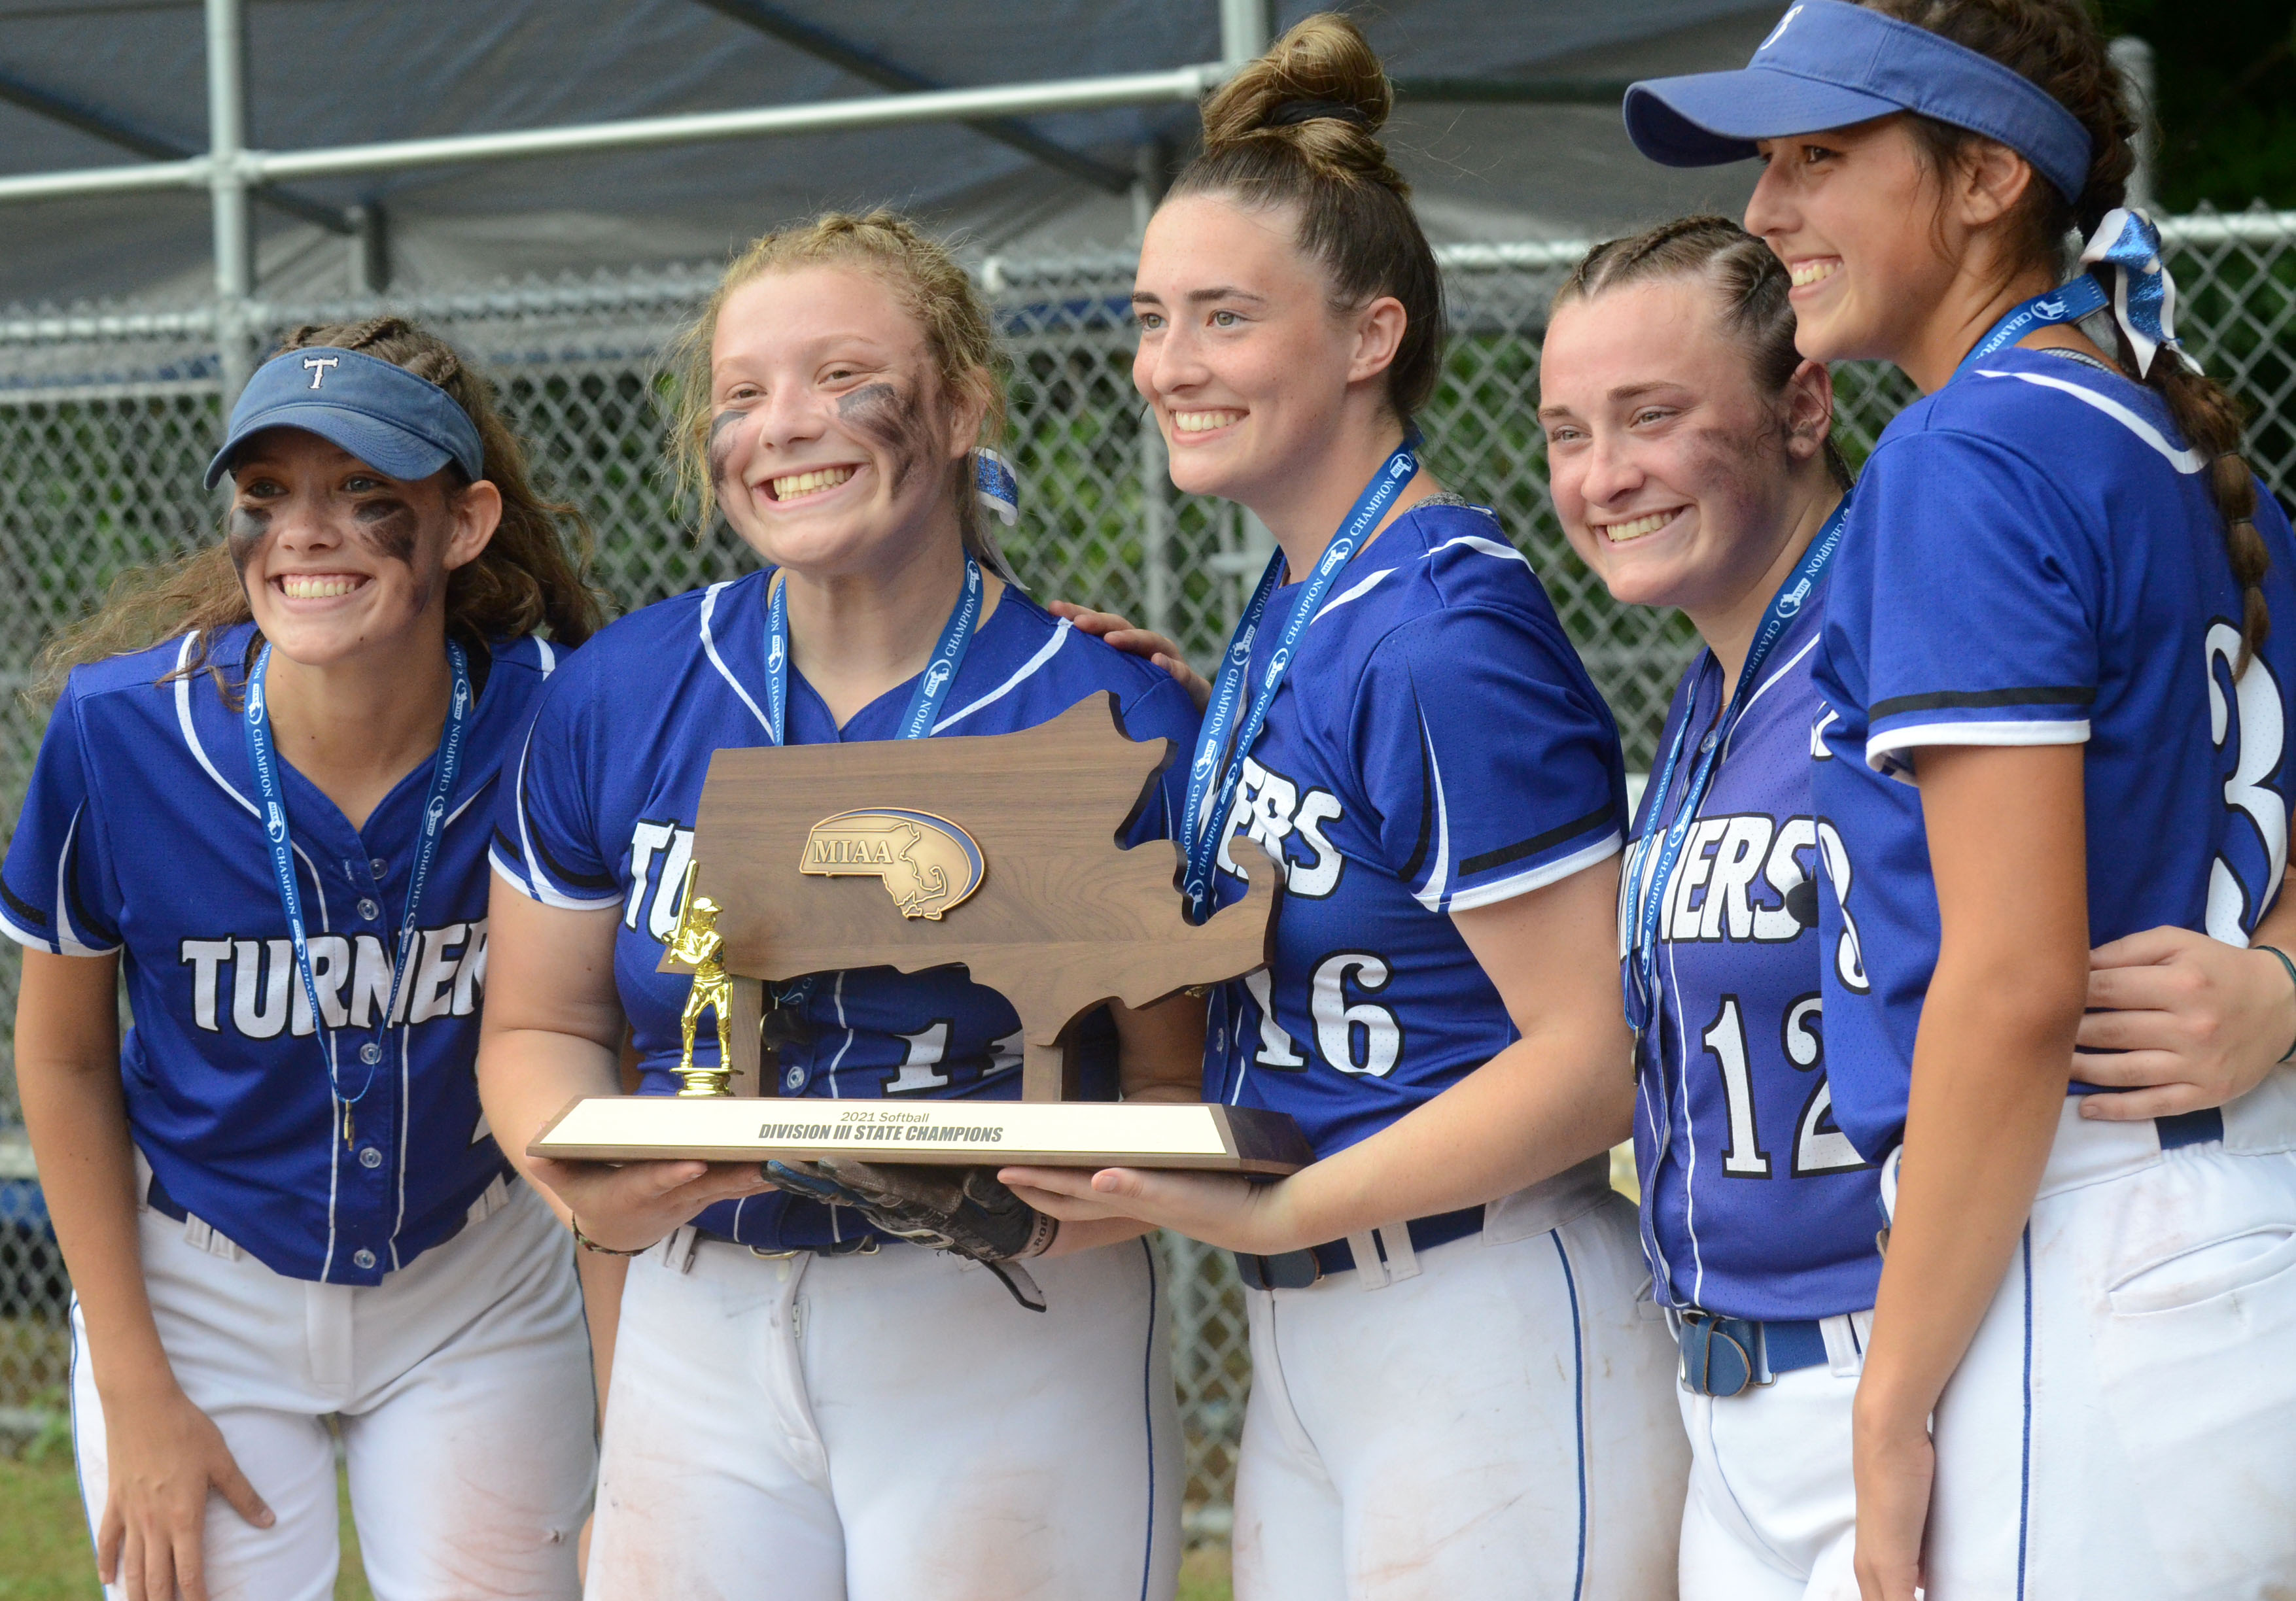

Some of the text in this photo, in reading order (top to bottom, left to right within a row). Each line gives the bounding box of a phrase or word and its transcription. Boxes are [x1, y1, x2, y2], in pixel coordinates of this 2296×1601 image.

[303, 356, 339, 389] T
[907, 700, 932, 740] MPION
[925, 677, 939, 697] MIAA
[945, 595, 975, 657] CHAMPION
[1198, 808, 1223, 876] CHAMPION
[1236, 691, 1268, 760] CHAMPION
[1285, 577, 1324, 645] CHAMPION
[1323, 555, 1338, 574] MIAA
[1349, 477, 1396, 536] CHAMPION
[1741, 620, 1781, 687] CHAMPION
[771, 676, 781, 744] CHAMPION
[1209, 668, 1239, 737] CHAMPION
[252, 729, 273, 797] CHAMPION
[276, 846, 297, 915] CHAMPION
[412, 840, 433, 908] CHAMPION
[440, 724, 461, 792] CHAMPION
[1183, 784, 1200, 859] CHAMPION
[1647, 762, 1672, 831] CHAMPION
[814, 840, 894, 865] MIAA
[1646, 852, 1673, 926] CHAMPION
[178, 916, 489, 1041] TURNER
[1243, 948, 1405, 1080] 16
[840, 1112, 930, 1123] 2021 Softball
[1701, 991, 1872, 1179] 12
[758, 1124, 1003, 1143] DIVISION III STATE CHAMPIONS
[1033, 1214, 1049, 1247] ROD
